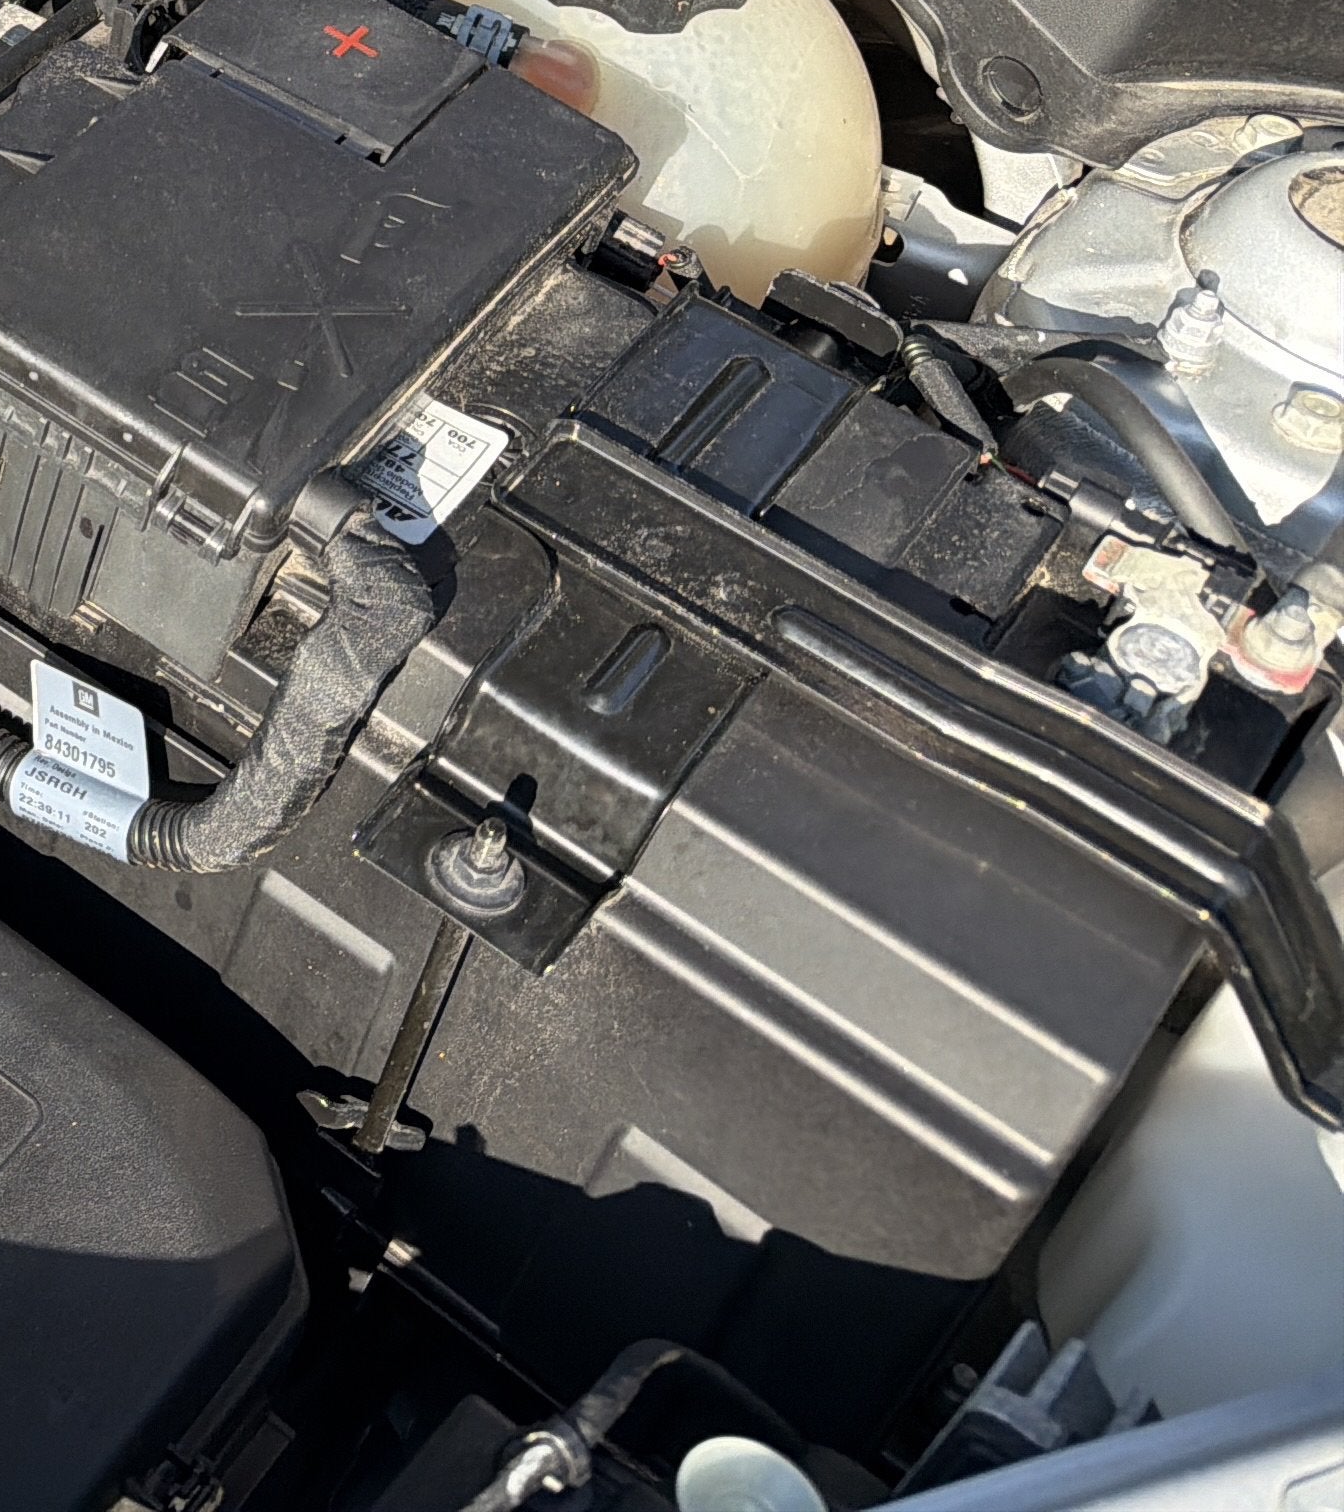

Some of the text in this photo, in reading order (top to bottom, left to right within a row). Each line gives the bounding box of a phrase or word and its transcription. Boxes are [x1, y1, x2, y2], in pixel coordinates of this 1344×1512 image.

[448, 429, 476, 449] 700
[50, 705, 90, 731] Assembly
[92, 724, 100, 735] in
[45, 734, 116, 778] 84301795
[84, 822, 107, 839] 202
